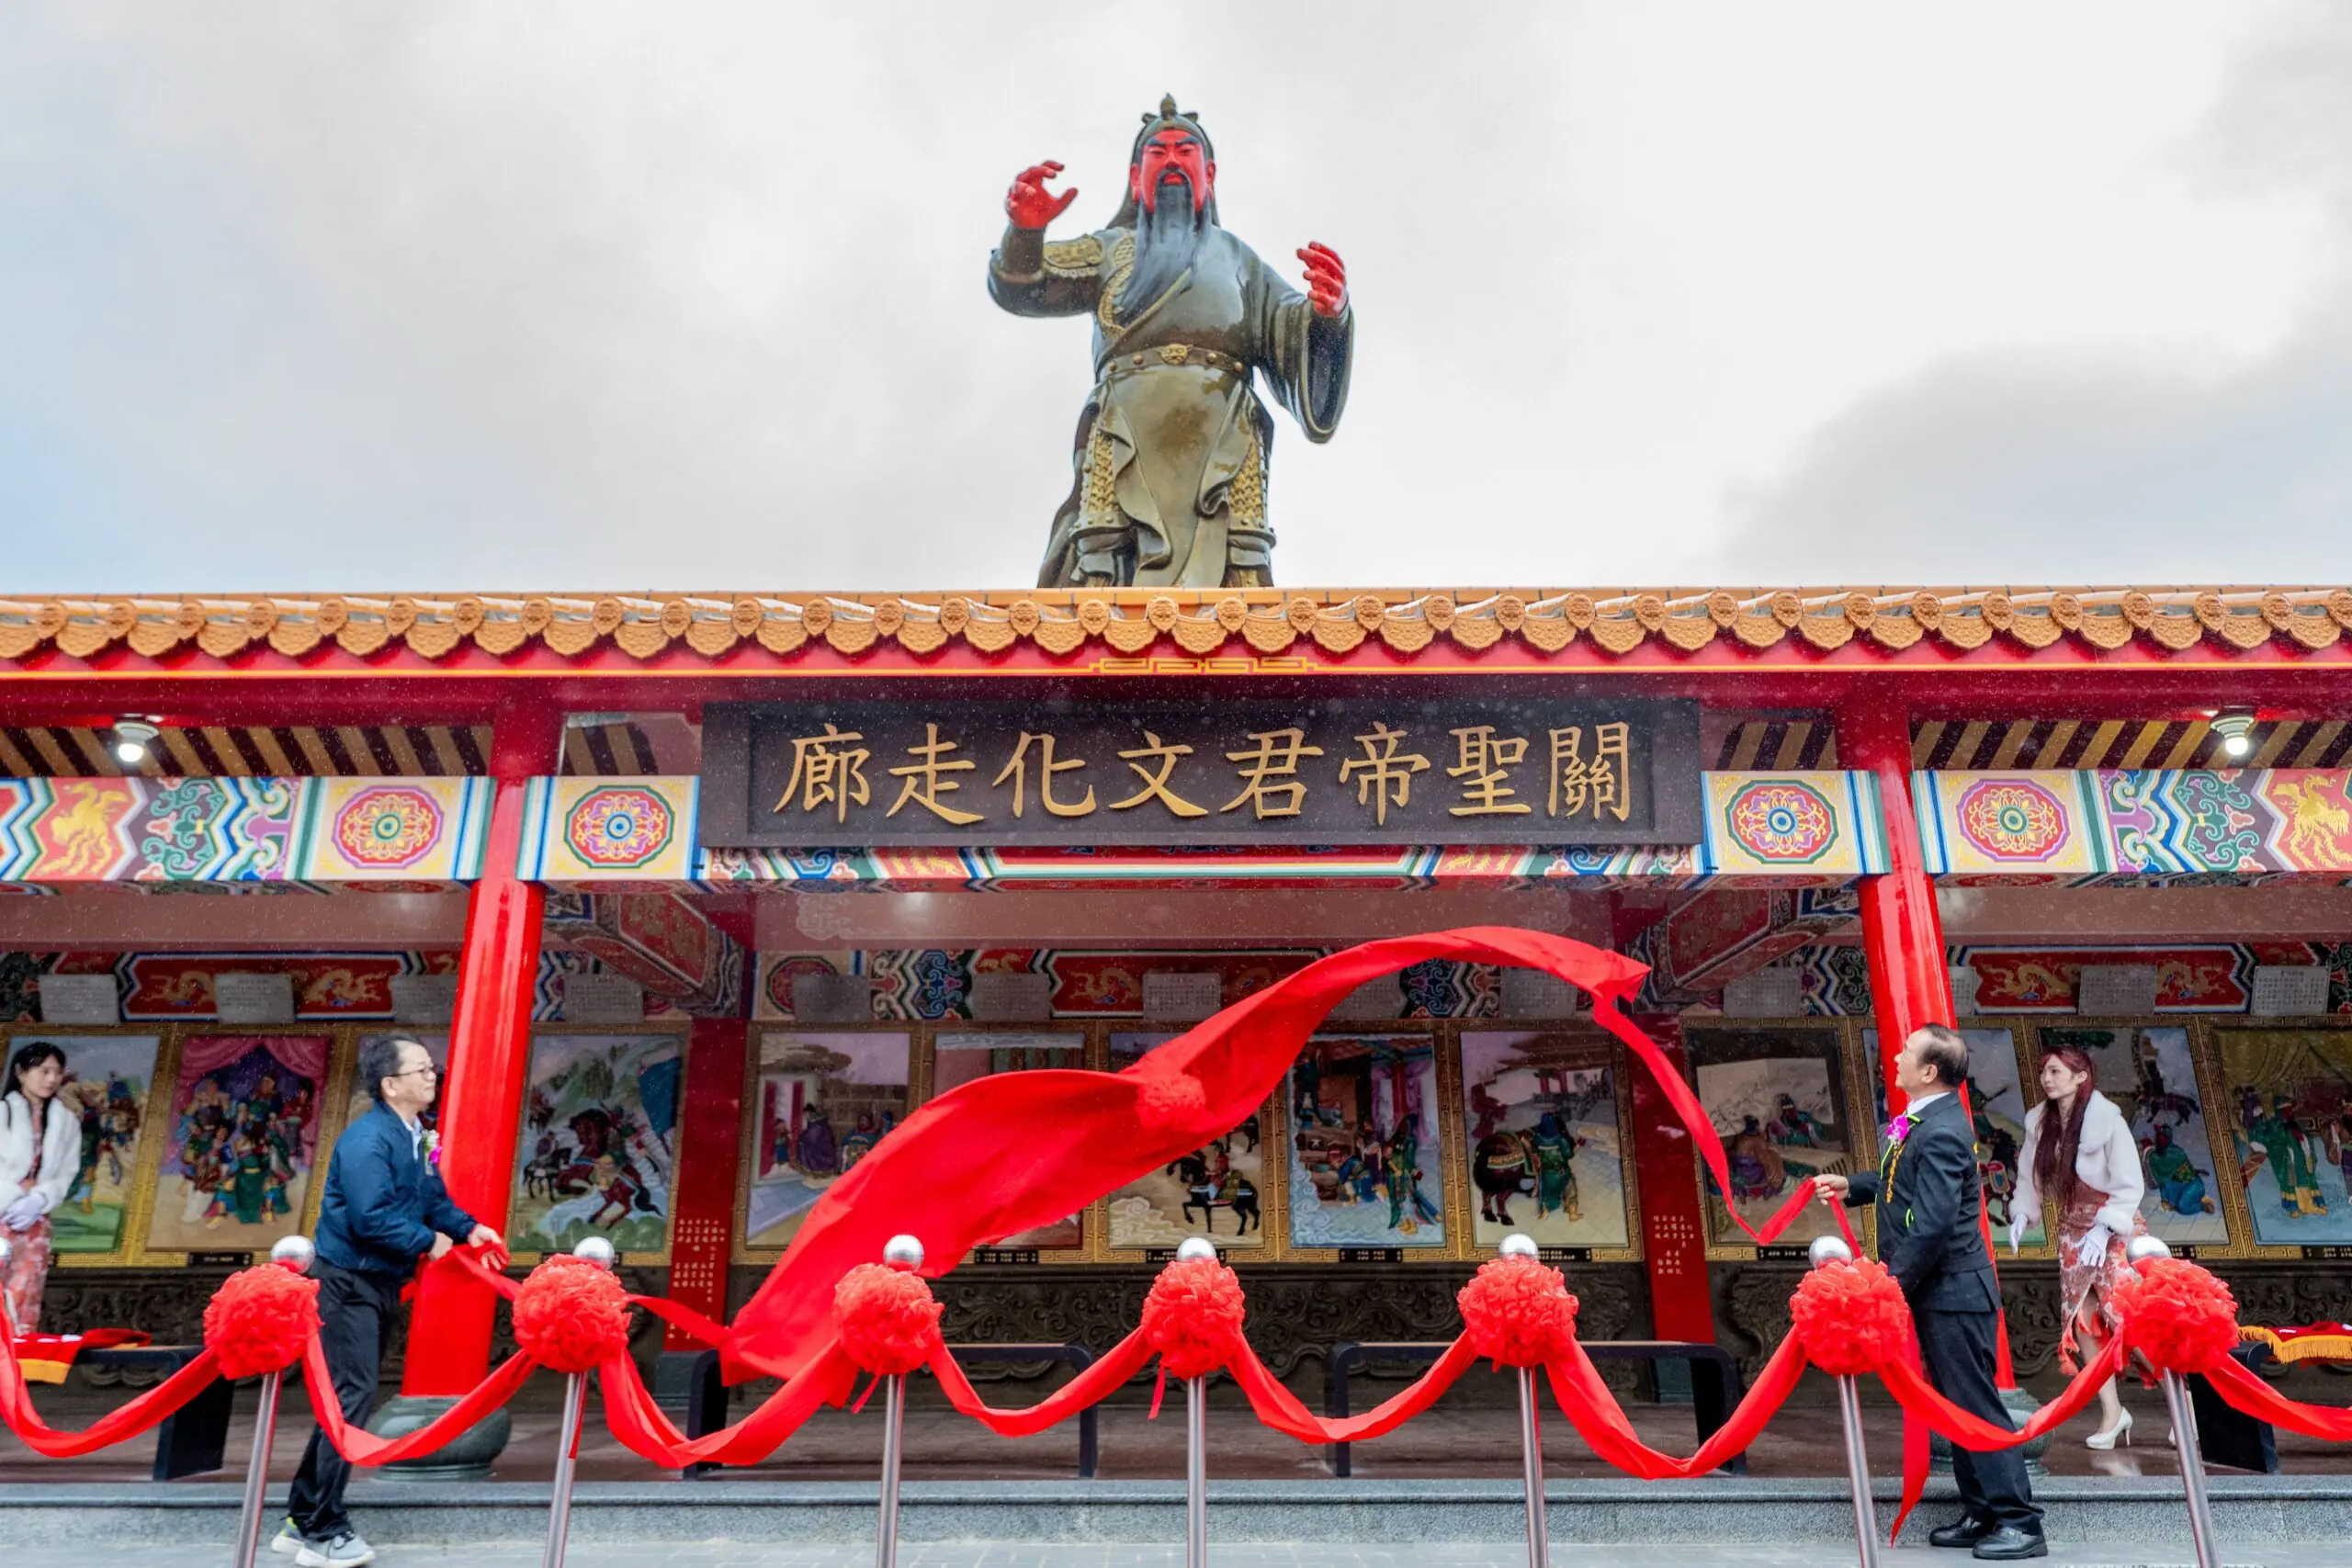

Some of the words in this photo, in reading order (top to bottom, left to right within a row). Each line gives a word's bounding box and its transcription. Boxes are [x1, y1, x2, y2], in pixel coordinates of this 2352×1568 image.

[774, 722, 1632, 825] 關聖帝君文化走廊
